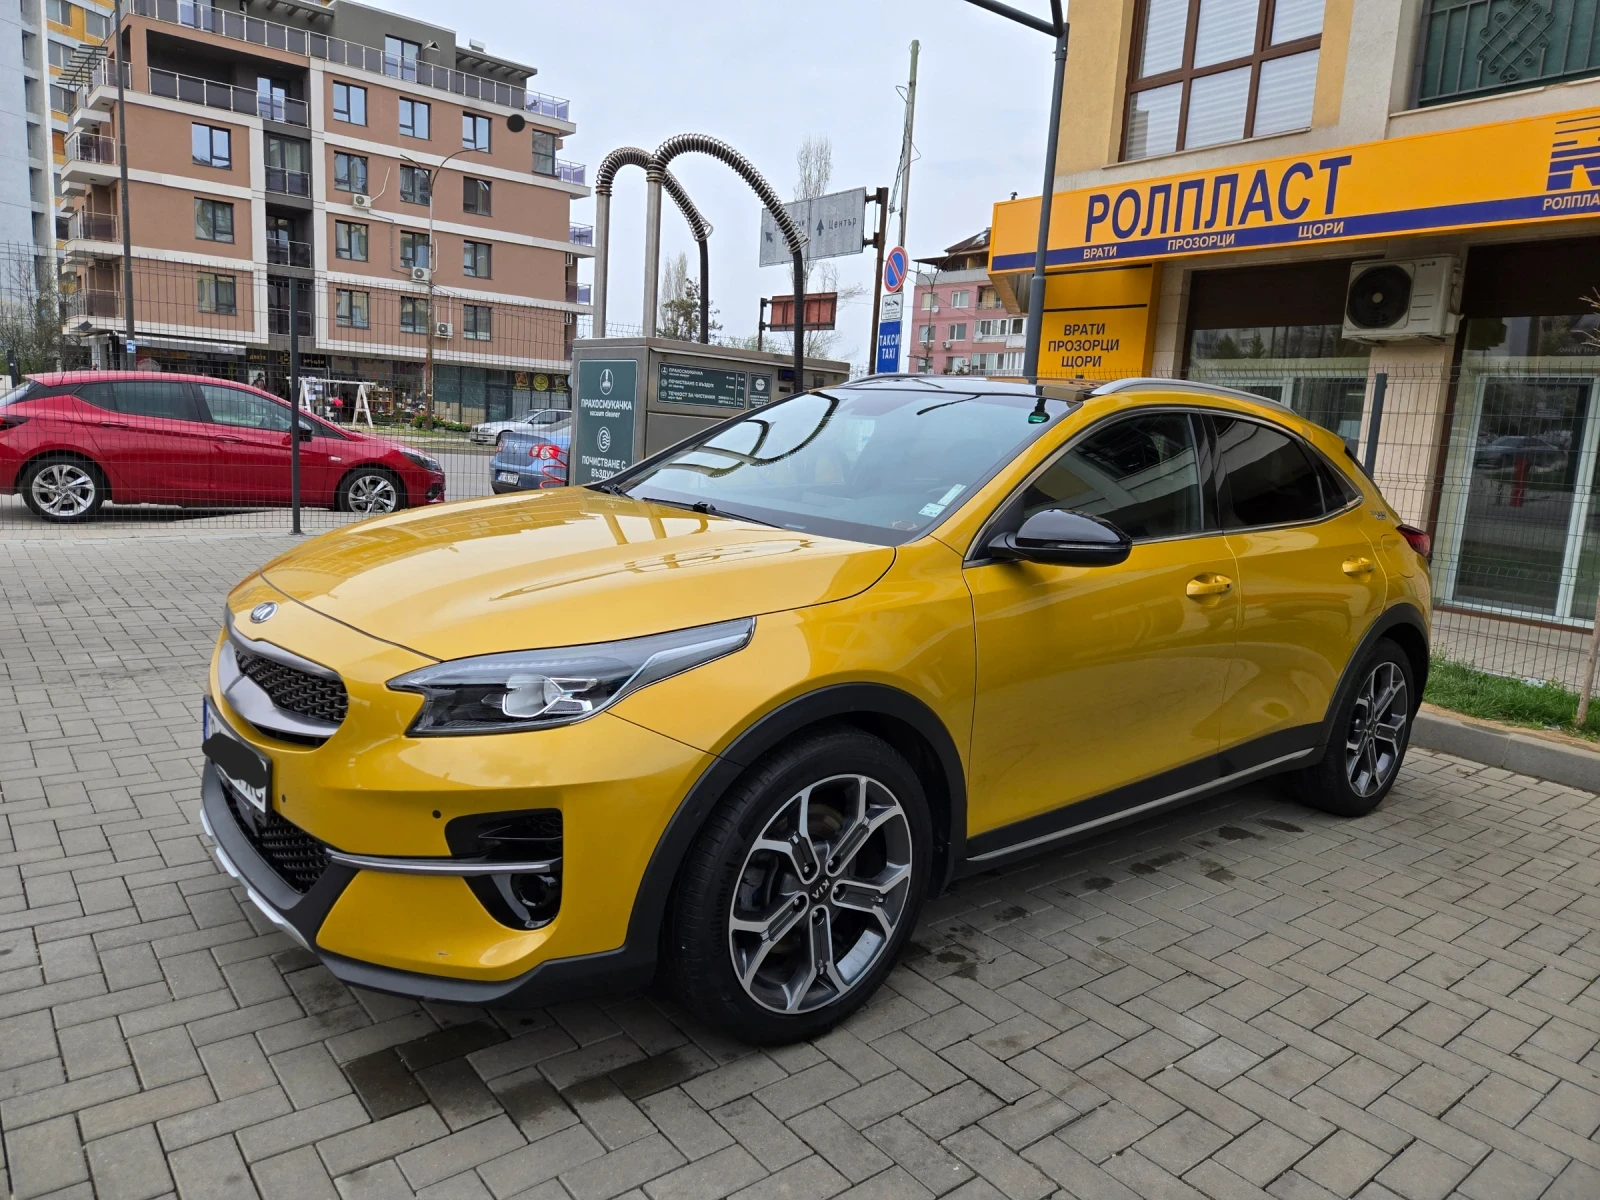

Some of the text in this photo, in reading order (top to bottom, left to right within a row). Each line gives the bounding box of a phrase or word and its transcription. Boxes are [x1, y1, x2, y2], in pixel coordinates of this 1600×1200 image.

[1085, 155, 1352, 243] РОЛПЛАСТ
[828, 217, 857, 230] Център
[1083, 221, 1344, 259] ВРАТИ ПРОЗОРЦИ ЩОРИ
[1064, 323, 1106, 336] ВРАТИ
[879, 334, 900, 346] ТАКСИ
[1048, 339, 1120, 353] ПРОЗОРЦИ
[882, 347, 896, 360] TAXI
[1061, 355, 1102, 369] ЩОРИ
[580, 398, 633, 411] ПРАХОСМУКАЧКА
[605, 410, 621, 418] cleaner
[581, 455, 627, 470] ПОЧИСТВАНЕ С
[590, 468, 615, 478] ВЪЗДУХ
[811, 879, 830, 899] KIA
